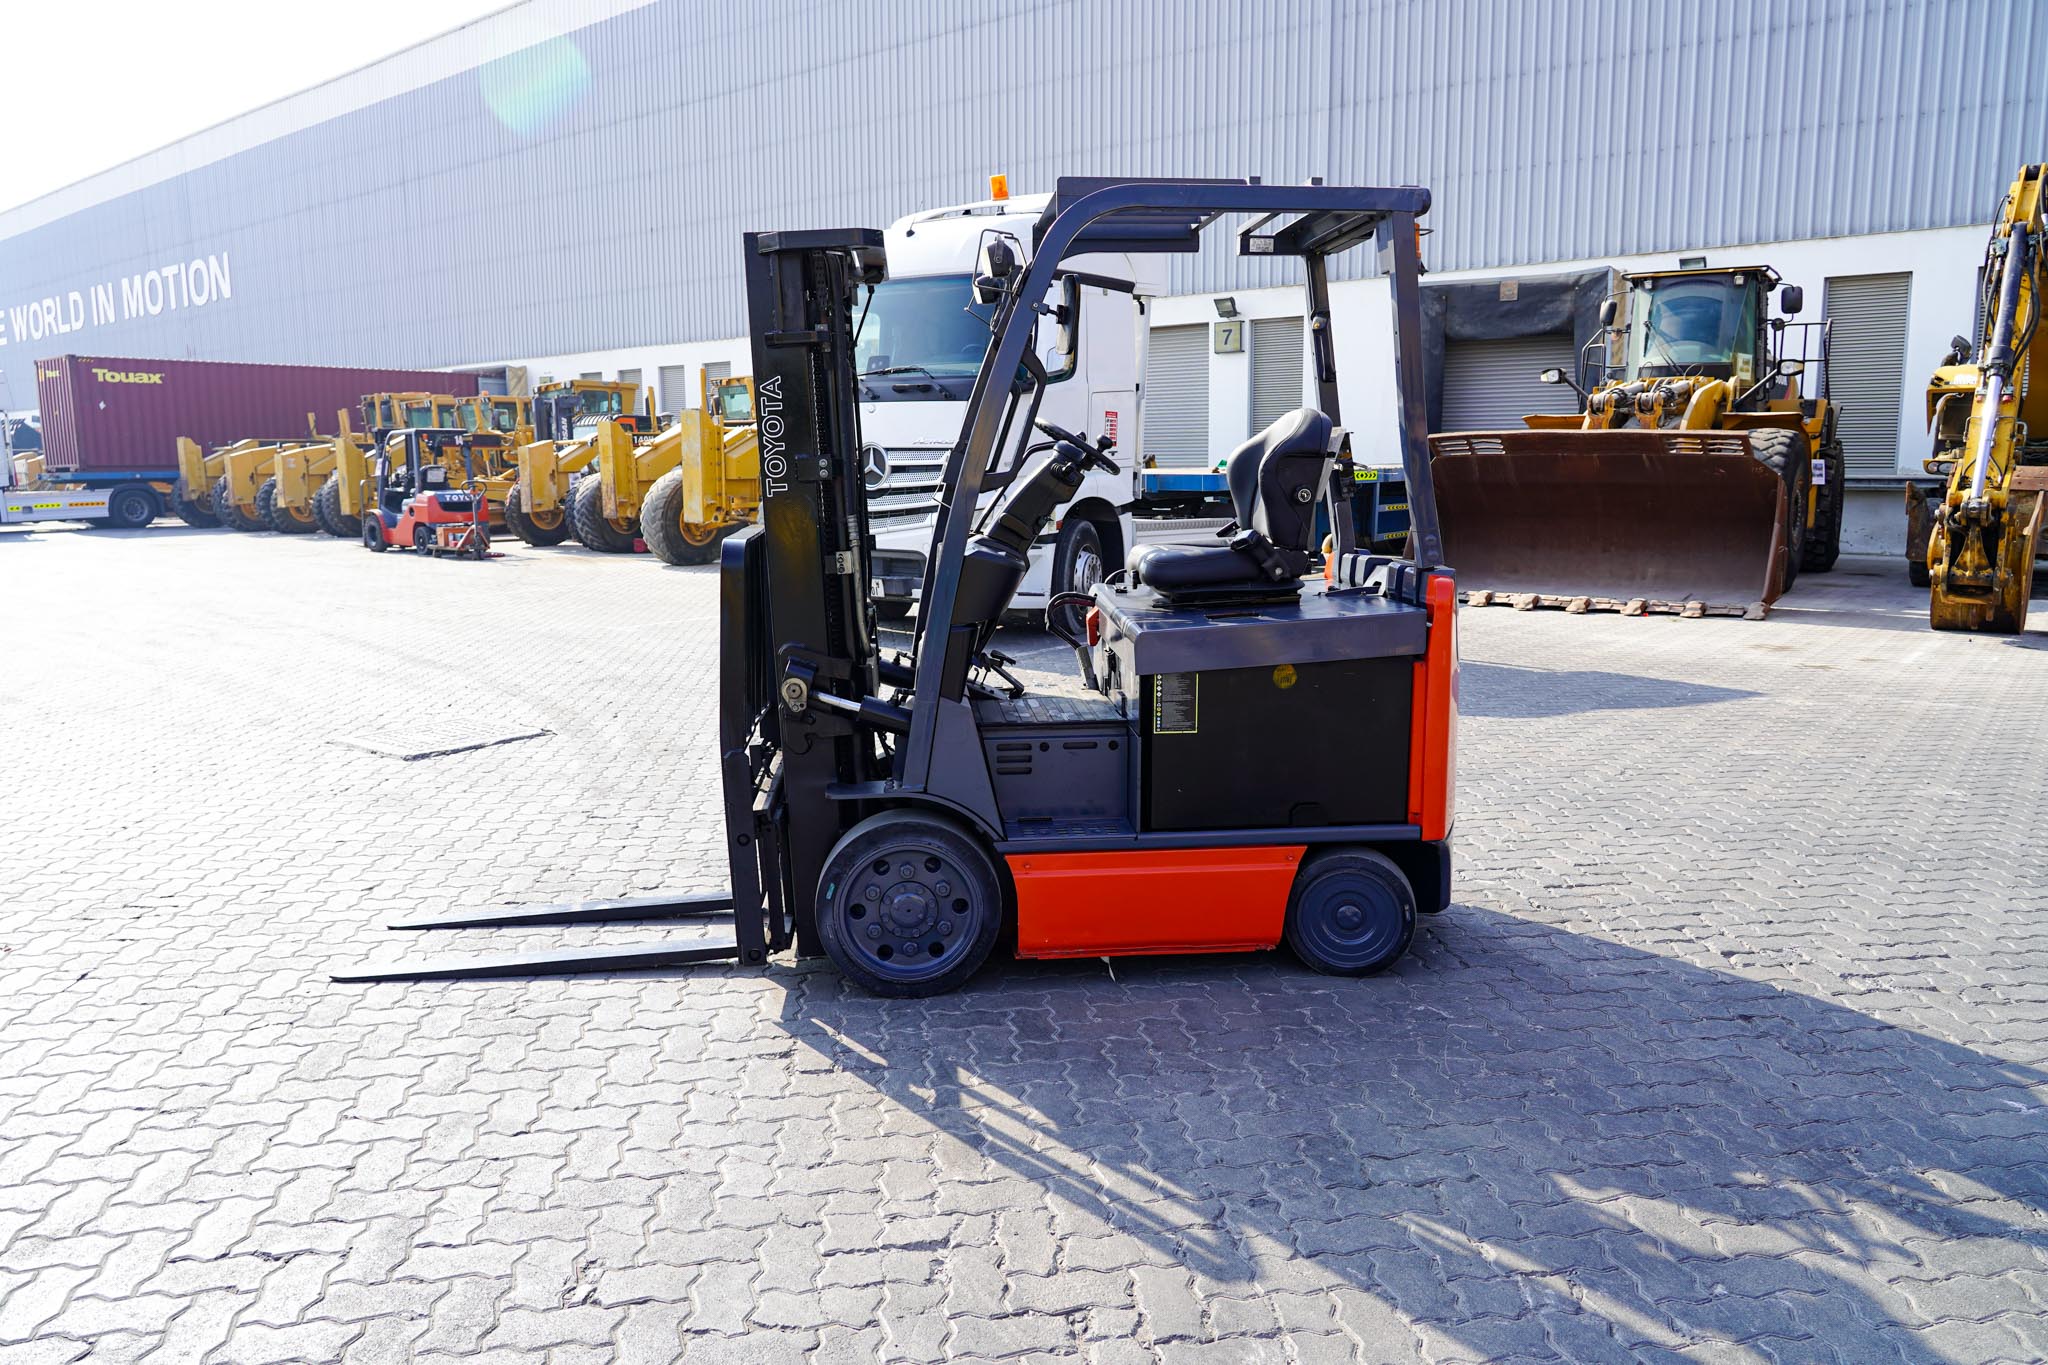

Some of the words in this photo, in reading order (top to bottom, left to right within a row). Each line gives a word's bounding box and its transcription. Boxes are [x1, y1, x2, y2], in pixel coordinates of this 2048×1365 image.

[9, 291, 85, 343] WORLD
[90, 282, 116, 327] IN
[121, 251, 232, 319] MOTION
[1222, 328, 1233, 346] 7
[92, 367, 163, 384] Touax
[760, 375, 789, 497] TOYOTA
